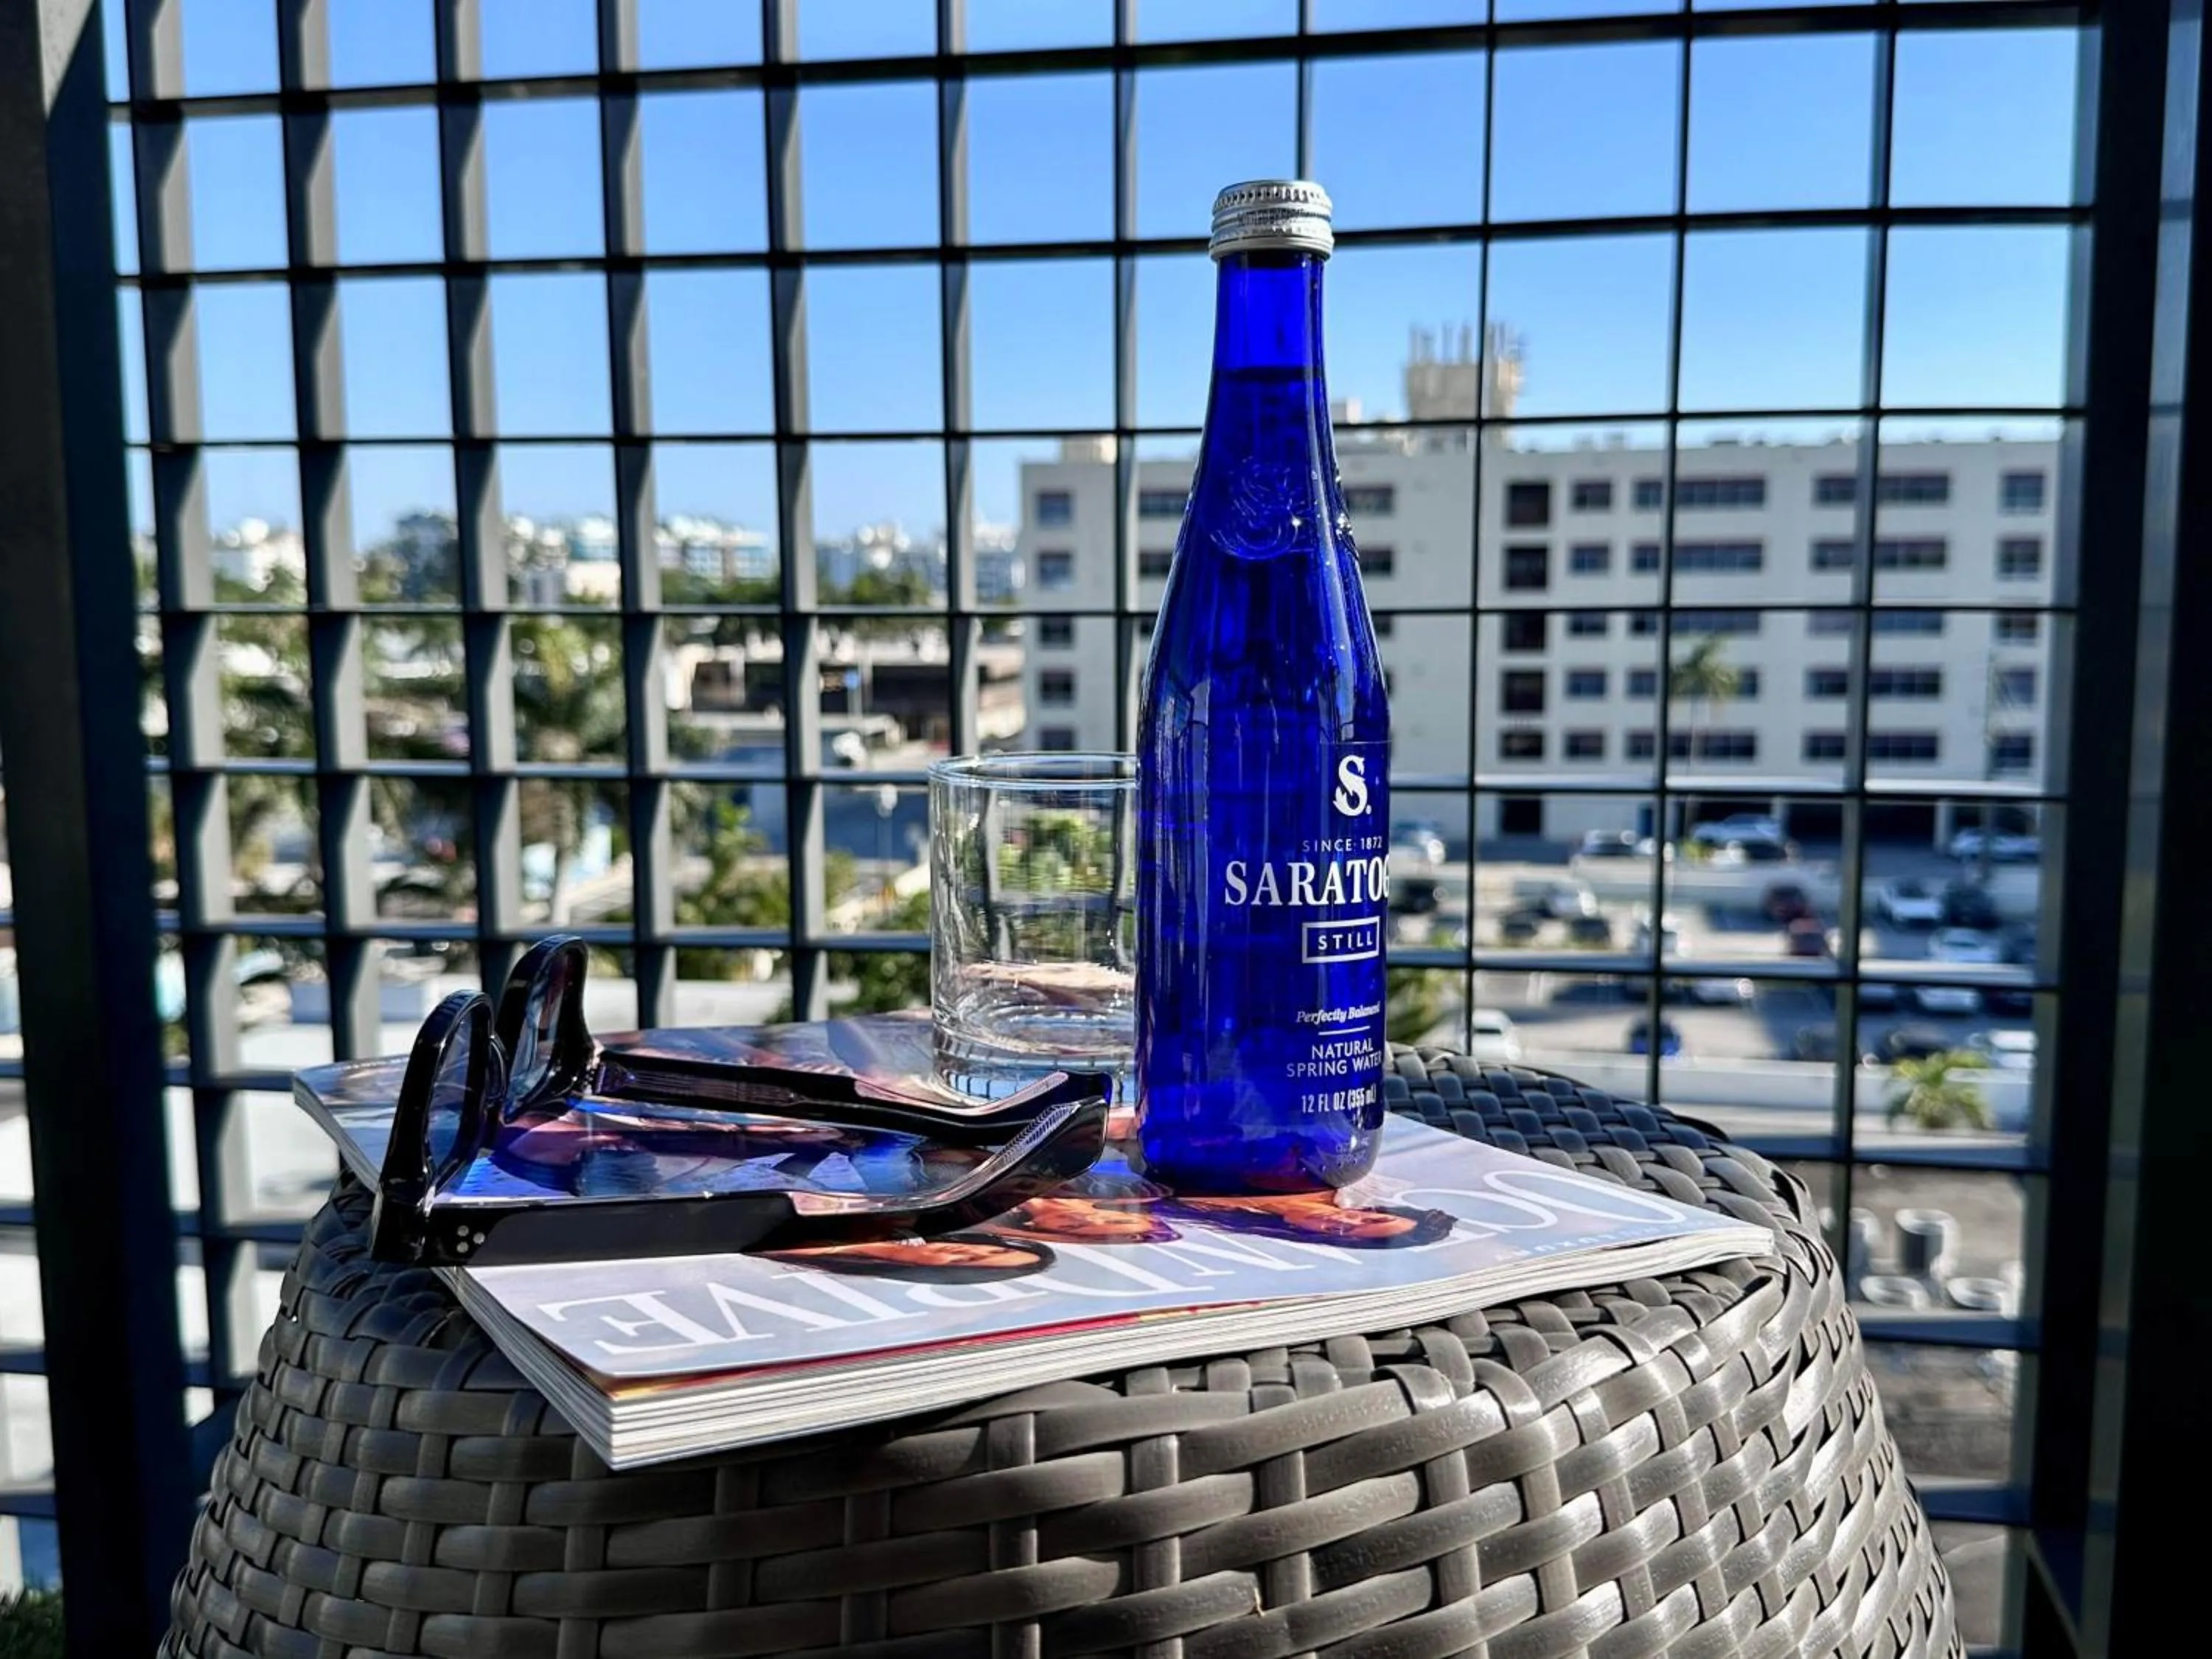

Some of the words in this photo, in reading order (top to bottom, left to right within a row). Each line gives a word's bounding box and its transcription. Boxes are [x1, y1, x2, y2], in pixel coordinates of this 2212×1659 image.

[1302, 838, 1353, 852] SINCE
[1360, 835, 1382, 850] 1872
[1318, 930, 1373, 950] STILL
[1295, 1007, 1347, 1026] Perfectly
[1311, 1037, 1374, 1060] NATURAL
[1286, 1060, 1348, 1078] SPRING
[1352, 1050, 1382, 1073] WATER
[1301, 1094, 1315, 1114] 12
[1318, 1093, 1330, 1113] FL
[1333, 1091, 1346, 1111] OZ
